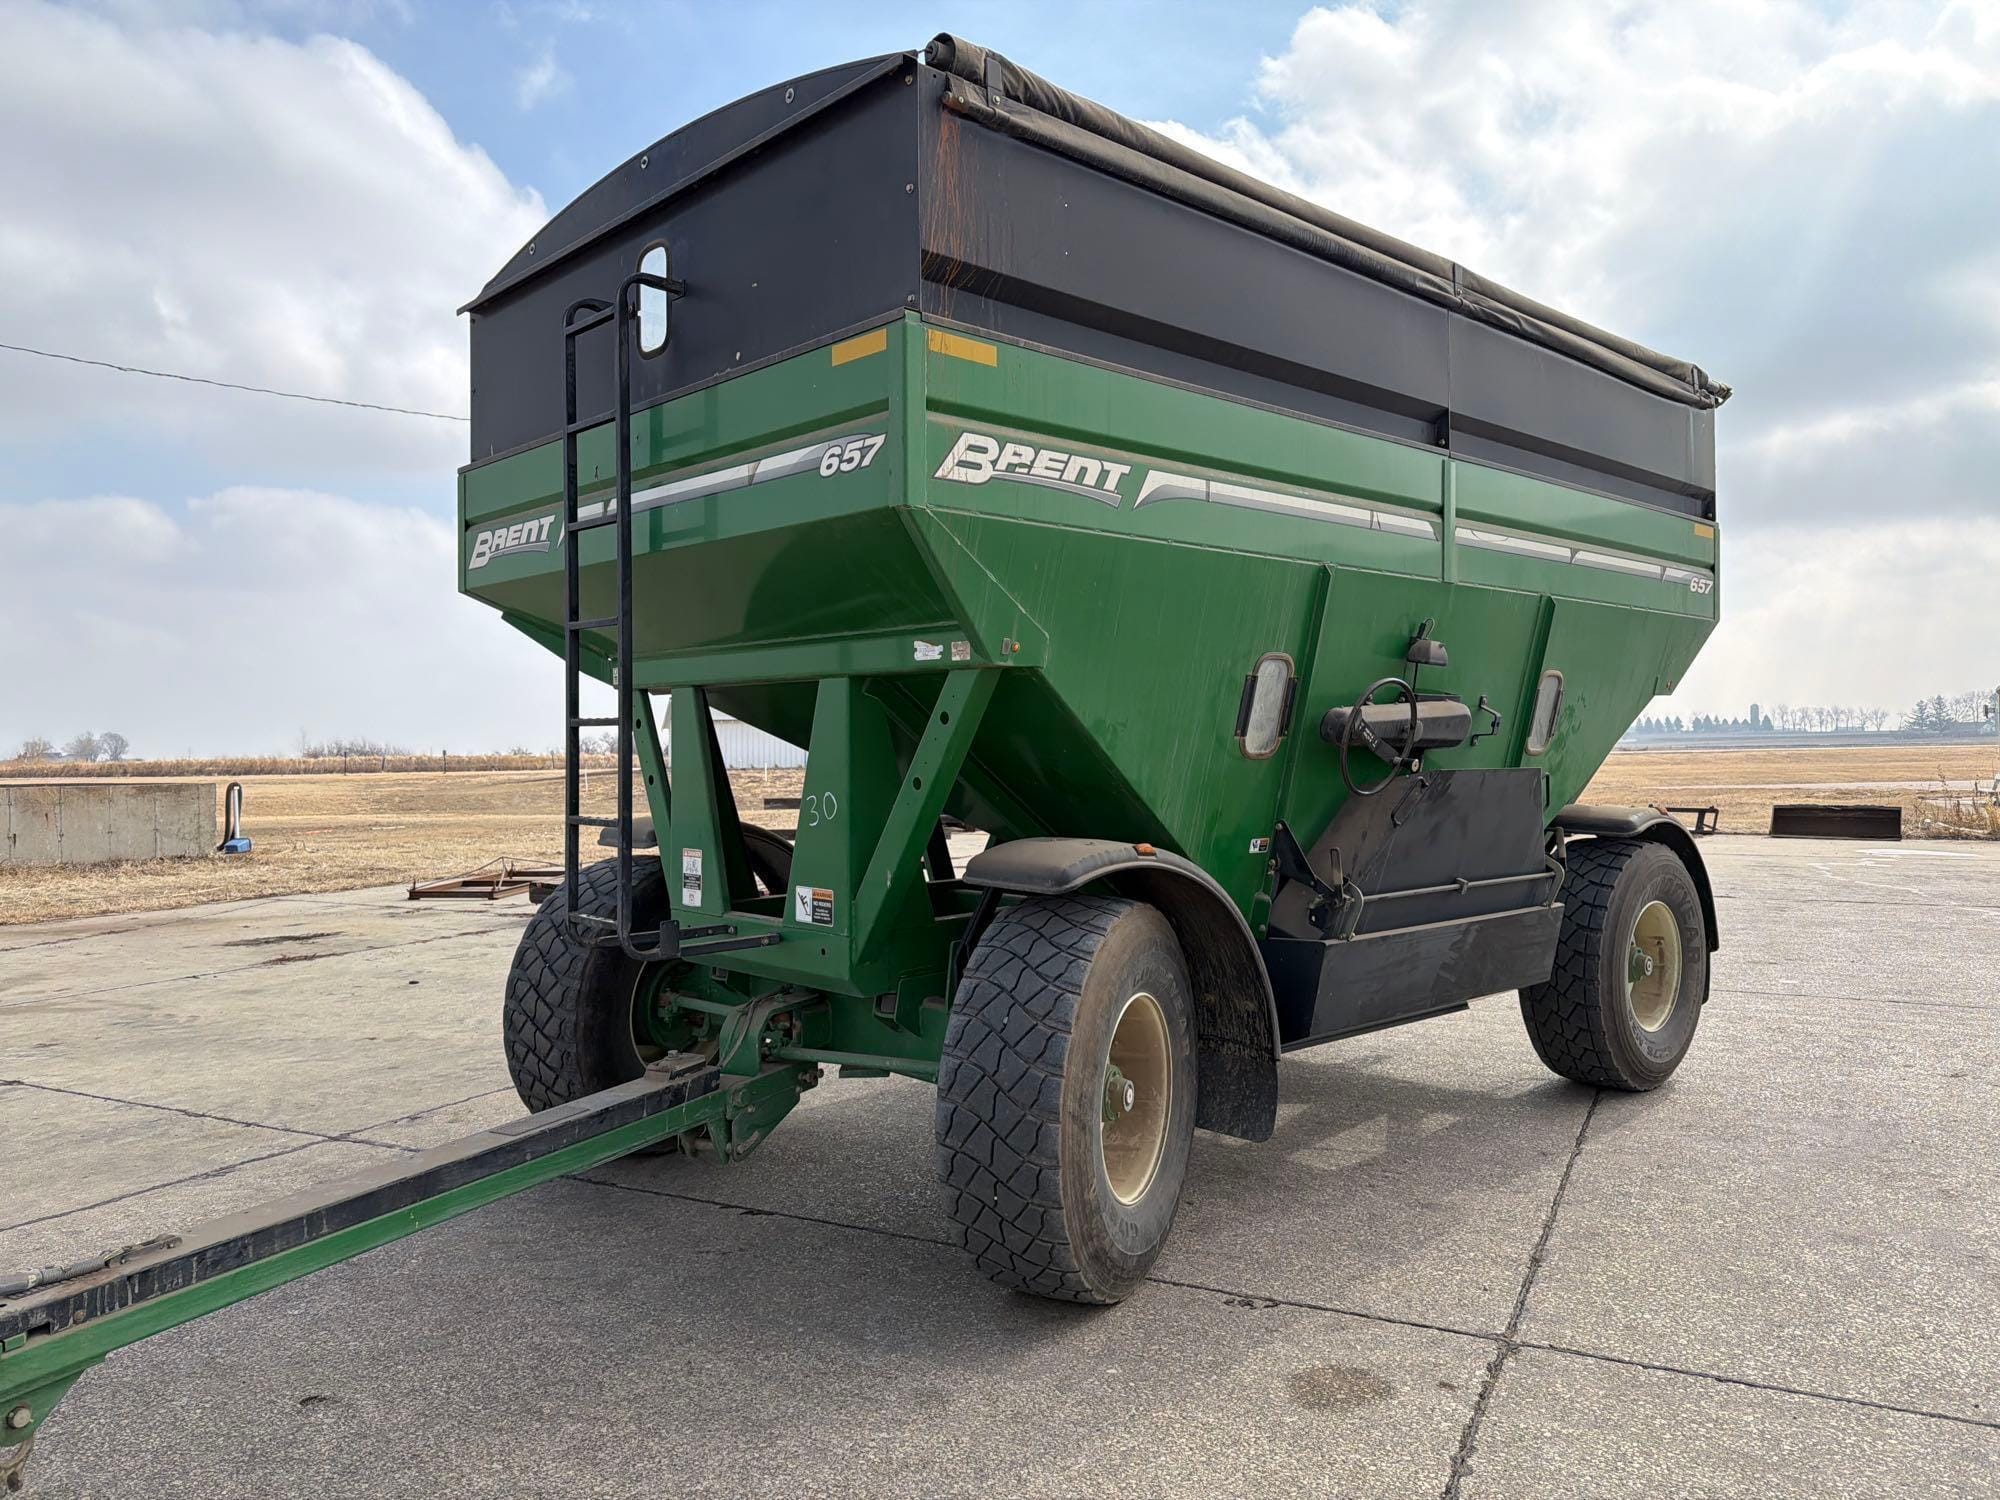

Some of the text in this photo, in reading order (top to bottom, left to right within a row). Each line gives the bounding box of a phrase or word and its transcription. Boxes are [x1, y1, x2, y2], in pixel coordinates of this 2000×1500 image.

[818, 433, 887, 478] 657
[1689, 577, 1714, 595] 657
[806, 791, 838, 827] 30
